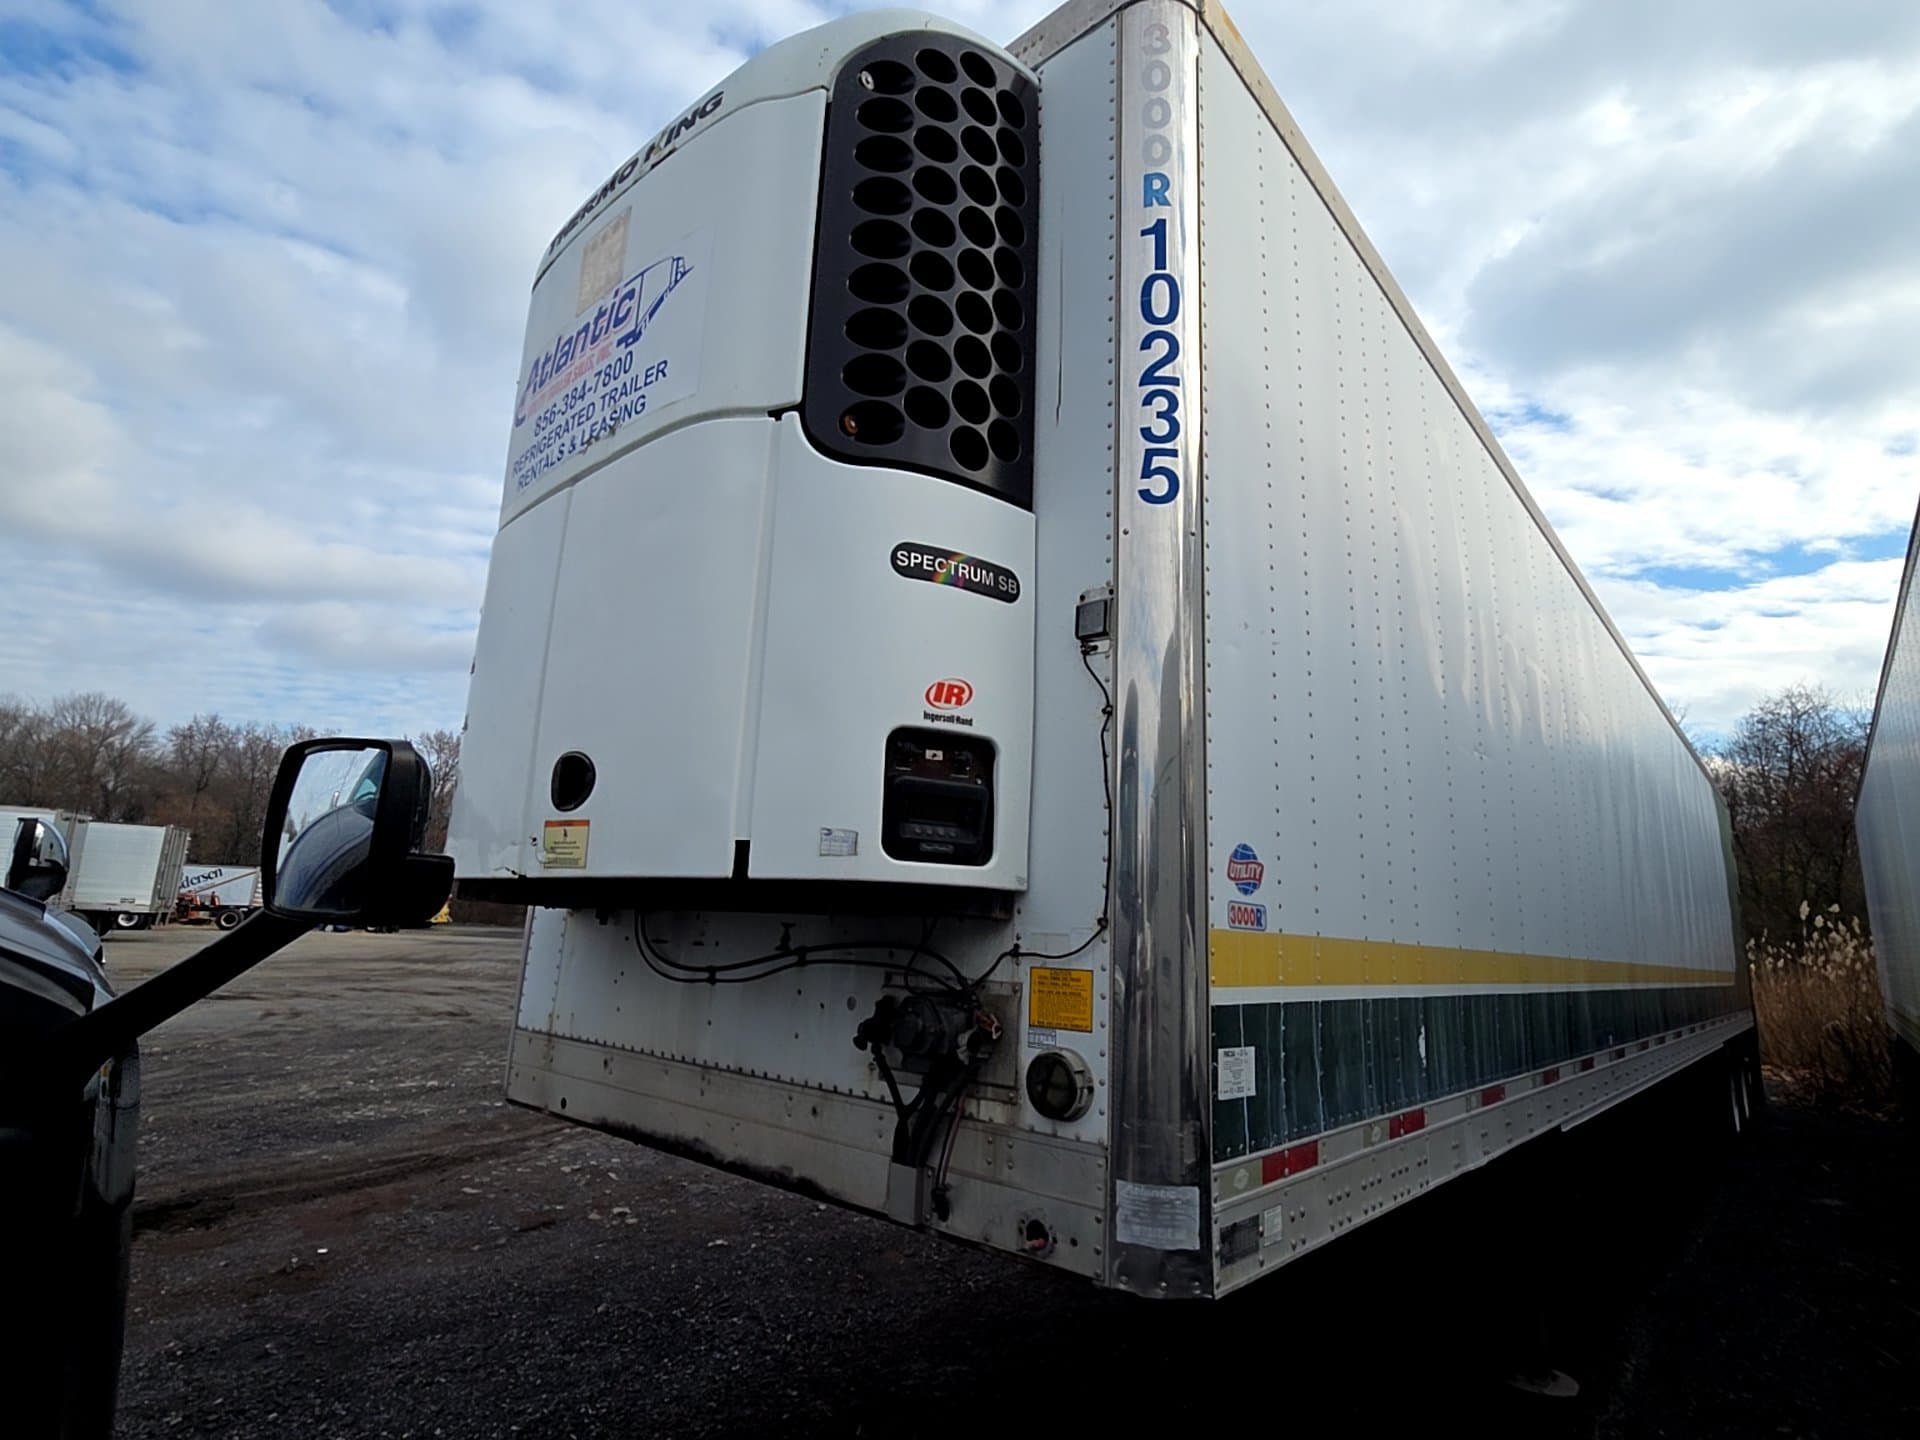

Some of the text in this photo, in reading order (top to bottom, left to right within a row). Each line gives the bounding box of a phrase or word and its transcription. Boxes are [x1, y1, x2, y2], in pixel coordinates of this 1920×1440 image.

[1142, 23, 1172, 208] 3000R
[518, 286, 638, 410] Atlantic
[1138, 218, 1180, 505] 10235
[513, 402, 596, 477] REFRIGERATED
[600, 359, 669, 412] TRAILER
[534, 350, 634, 438] 856-384-7800
[517, 395, 647, 492] RENTALS & LEASING
[896, 550, 1017, 594] SPECTRUM SB
[932, 682, 966, 706] IR
[180, 867, 223, 890] dersen
[1230, 862, 1263, 879] UTILITY
[1230, 904, 1263, 928] 3000R
